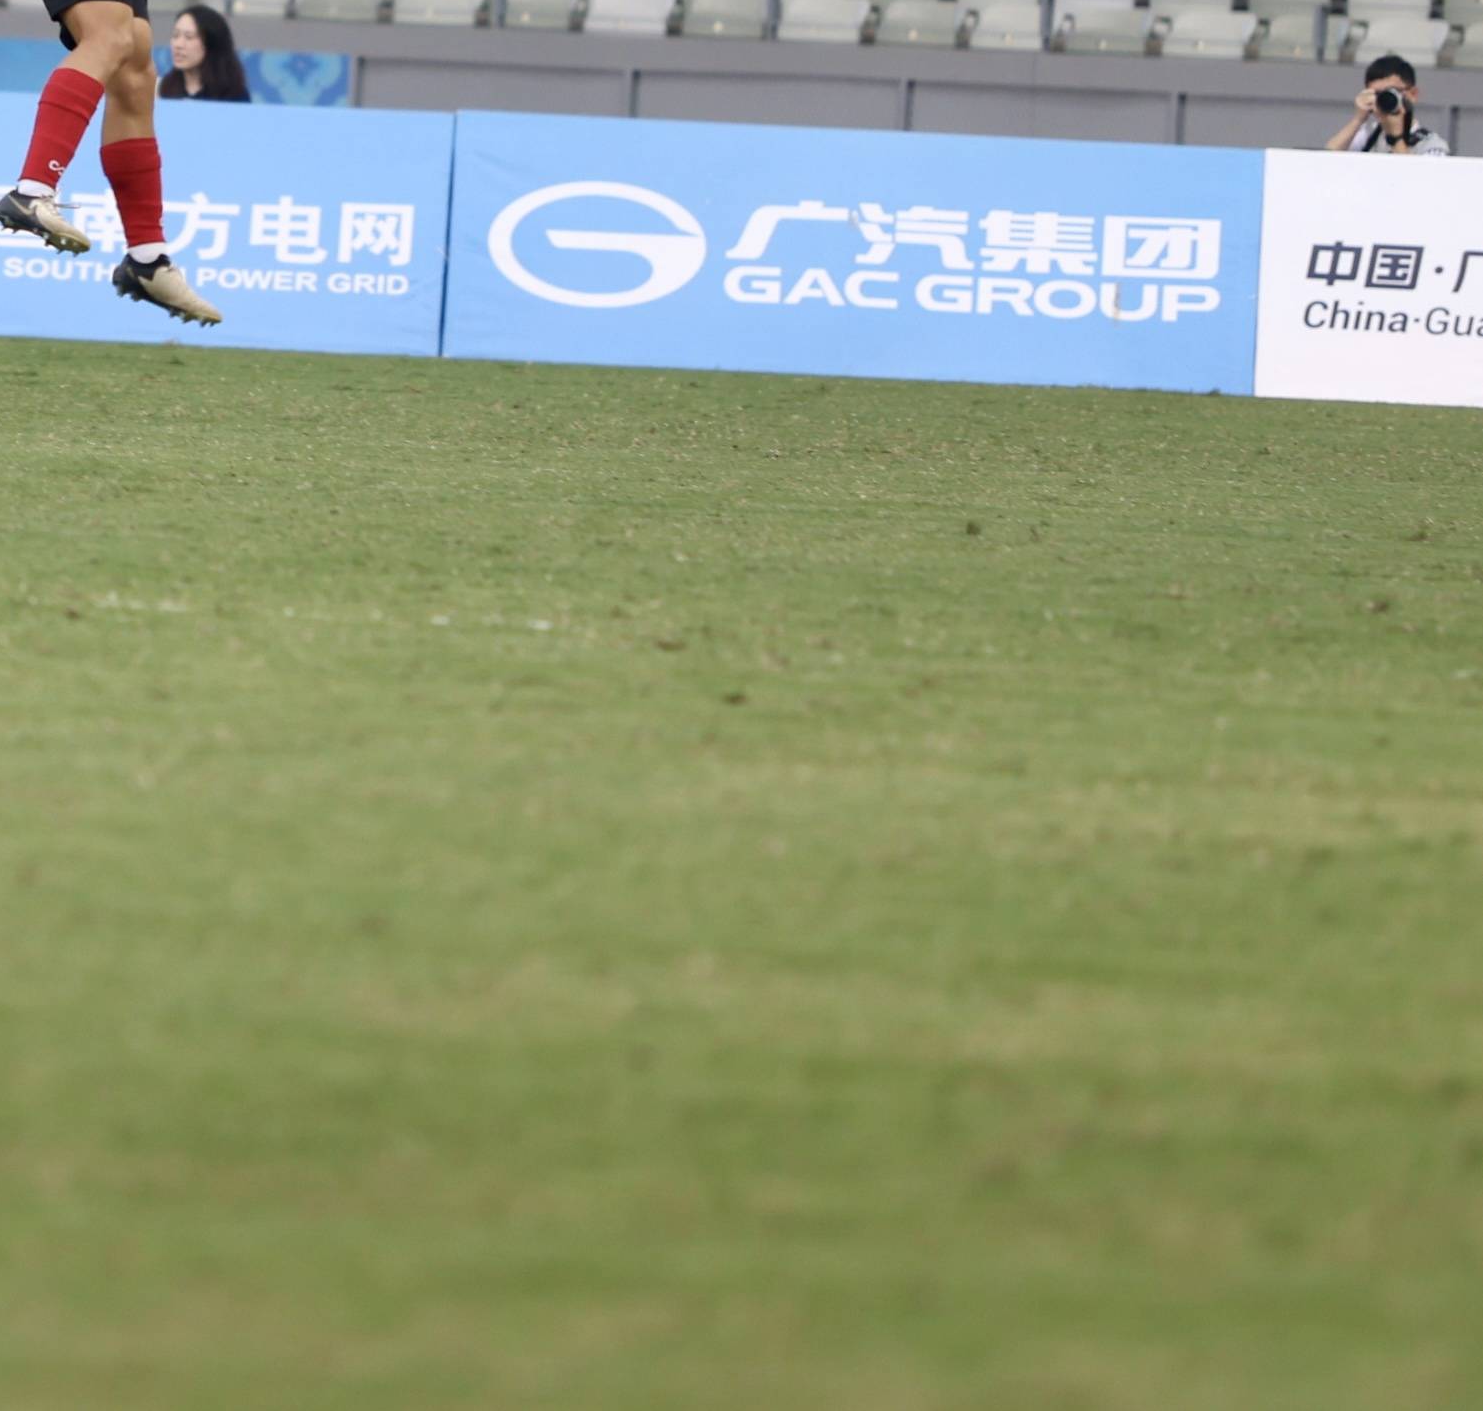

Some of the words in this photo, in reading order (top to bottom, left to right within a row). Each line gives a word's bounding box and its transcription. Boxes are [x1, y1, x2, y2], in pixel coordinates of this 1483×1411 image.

[725, 200, 1222, 279] 广汽集团
[3, 256, 187, 286] SOUTH
[196, 266, 318, 292] POWER
[326, 272, 410, 296] GRID
[723, 265, 900, 309] GAC
[915, 274, 1221, 322] GROUP
